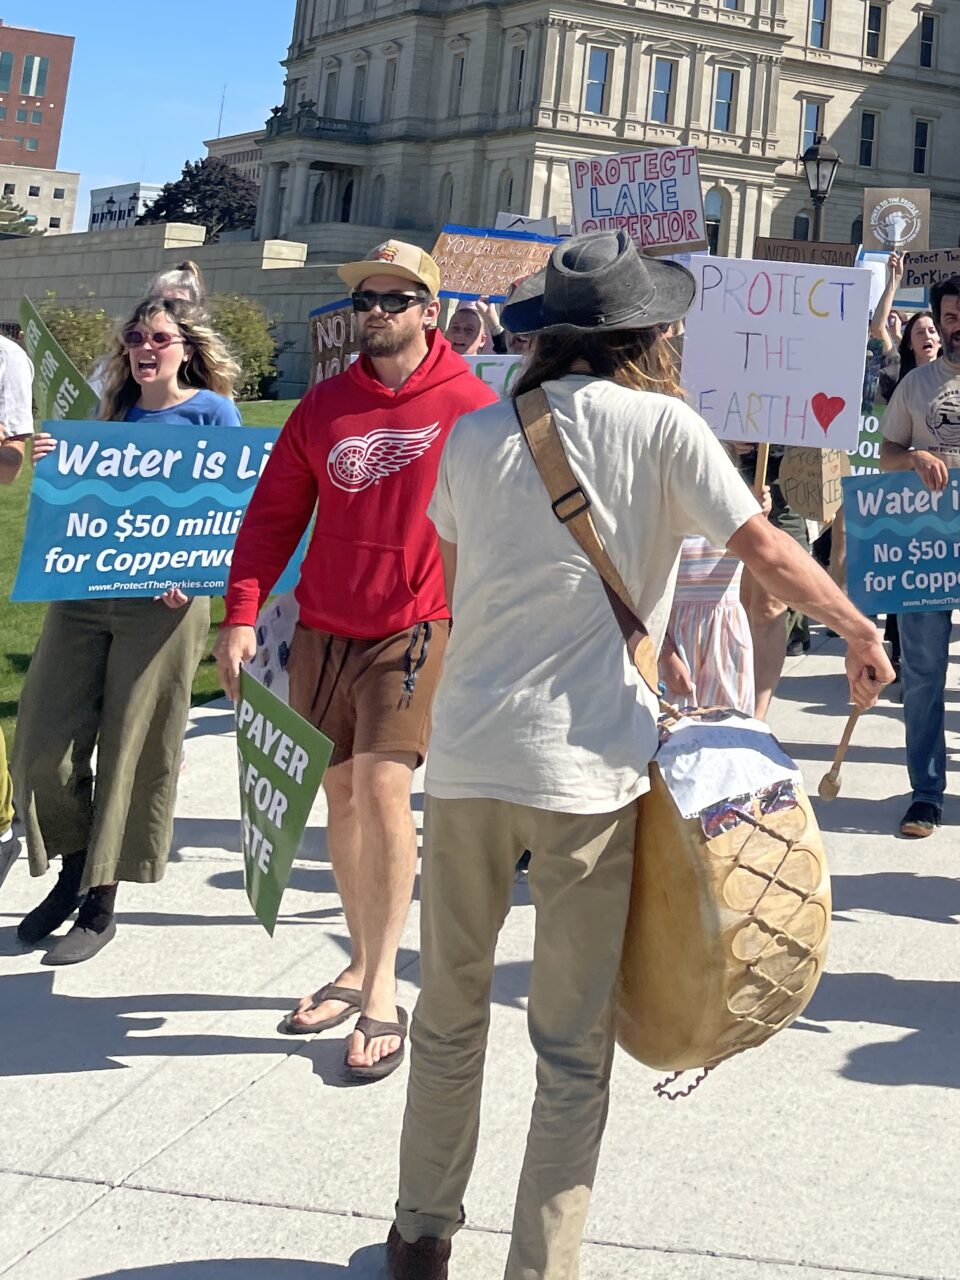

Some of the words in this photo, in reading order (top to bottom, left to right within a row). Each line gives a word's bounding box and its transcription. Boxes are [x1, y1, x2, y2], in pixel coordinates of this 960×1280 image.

[575, 148, 695, 188] PROTECT
[590, 178, 680, 218] LAKE
[470, 257, 547, 274] SUPERIO
[904, 251, 939, 265] Protect
[945, 251, 960, 262] The
[700, 264, 855, 321] PROTECT
[733, 331, 804, 372] THE
[700, 389, 808, 440] EARTH
[57, 440, 182, 479] Water
[193, 440, 227, 480] is
[857, 486, 944, 517] Water
[66, 512, 107, 538] No
[114, 509, 170, 543] $50
[176, 509, 243, 537] milli
[44, 547, 91, 573] for
[873, 544, 902, 563] No
[908, 537, 947, 564] $50
[88, 580, 224, 592] www.ProtectThePorkies.com
[864, 571, 896, 592] for
[238, 699, 309, 785] PAYER
[244, 763, 289, 829] FOR
